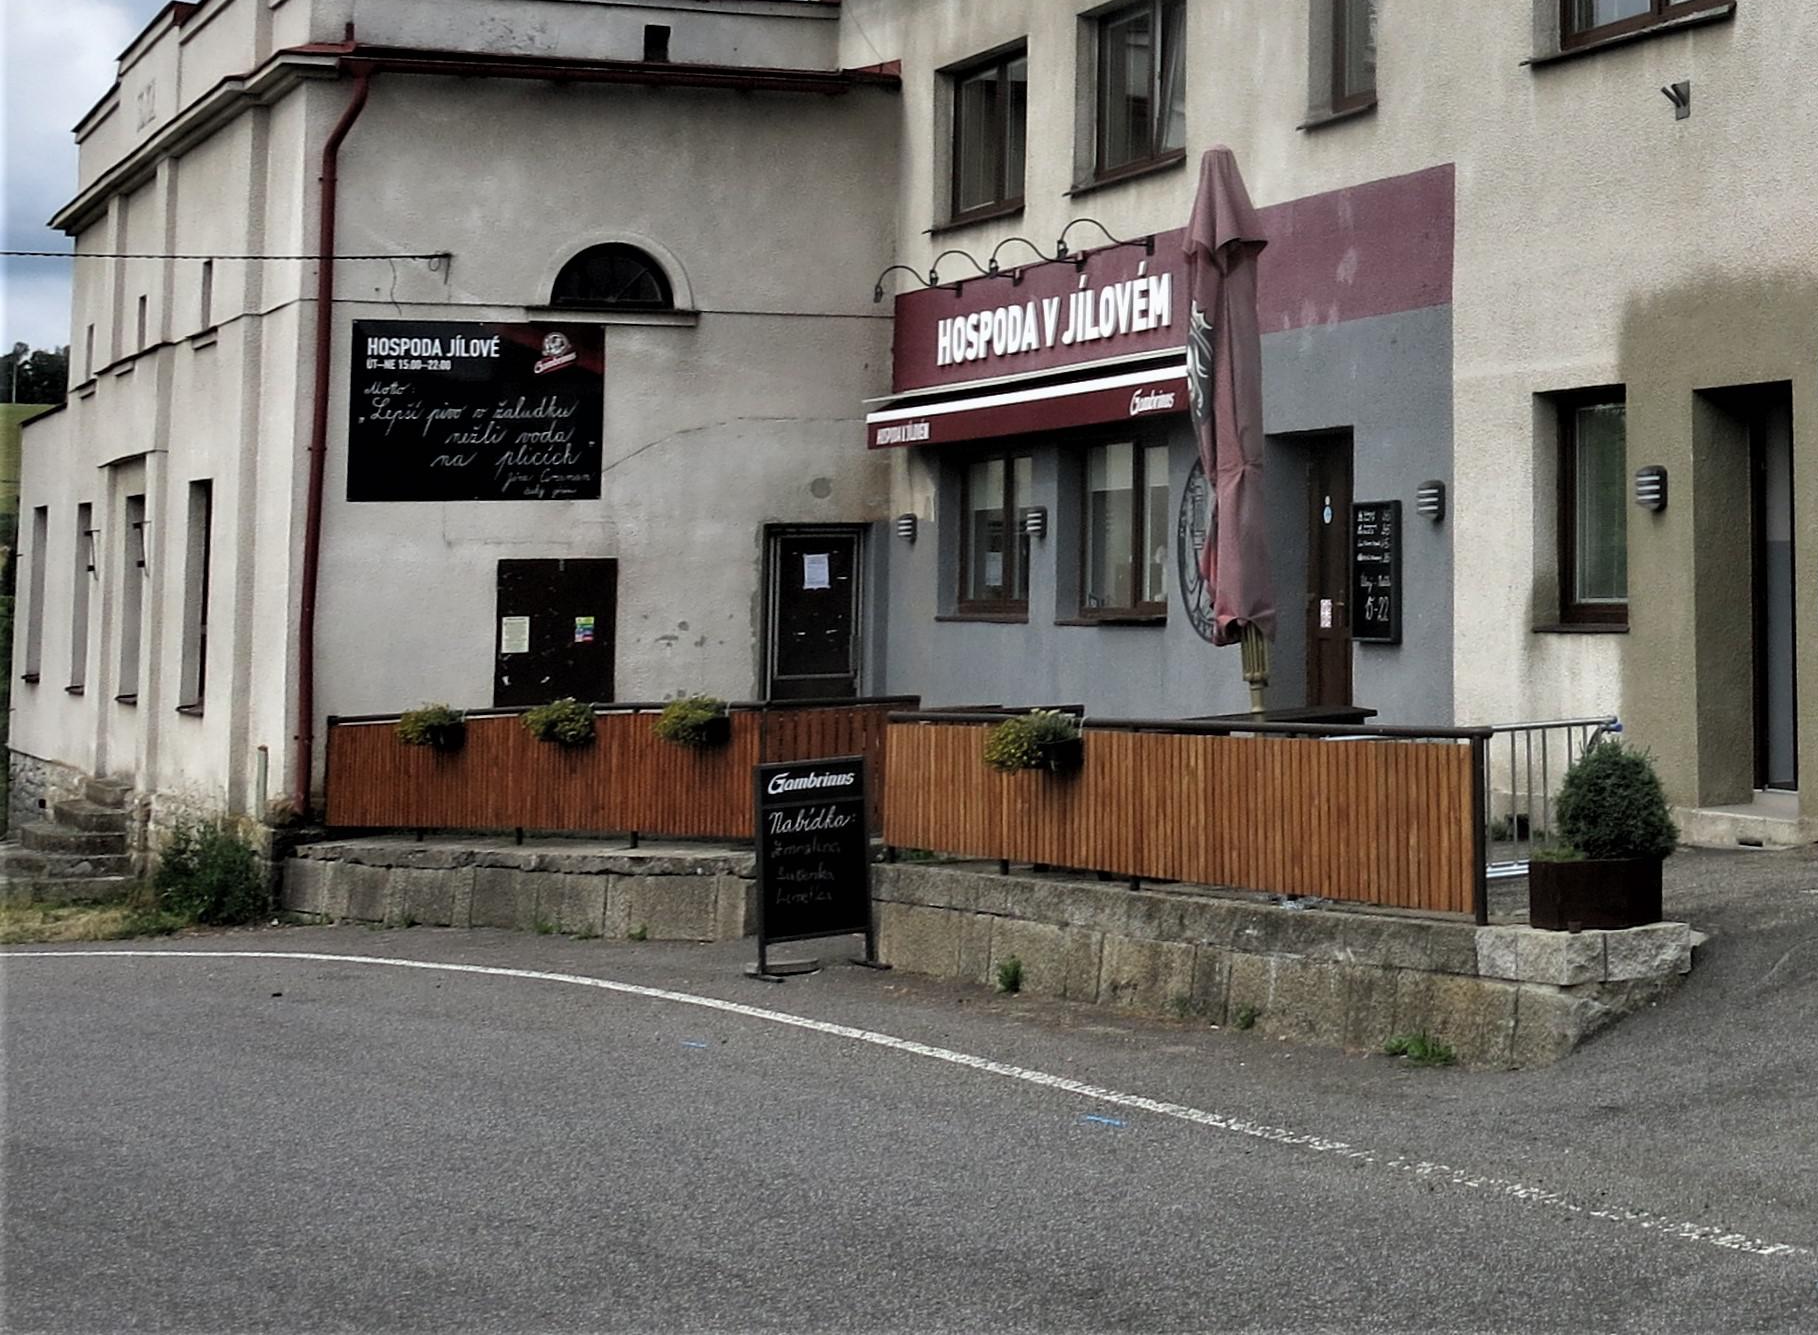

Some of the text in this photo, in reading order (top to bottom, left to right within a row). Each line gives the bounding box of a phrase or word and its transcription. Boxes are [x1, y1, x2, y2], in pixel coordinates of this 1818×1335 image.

[937, 261, 1173, 366] HOSPODA V JÍLOVÉM
[367, 334, 501, 358] HOSPODA JÍLOVÉ
[492, 396, 580, 420] žaludku
[514, 420, 575, 444] voda
[429, 452, 478, 467] na
[494, 443, 582, 480] plicích
[767, 771, 856, 795] Gambrinus
